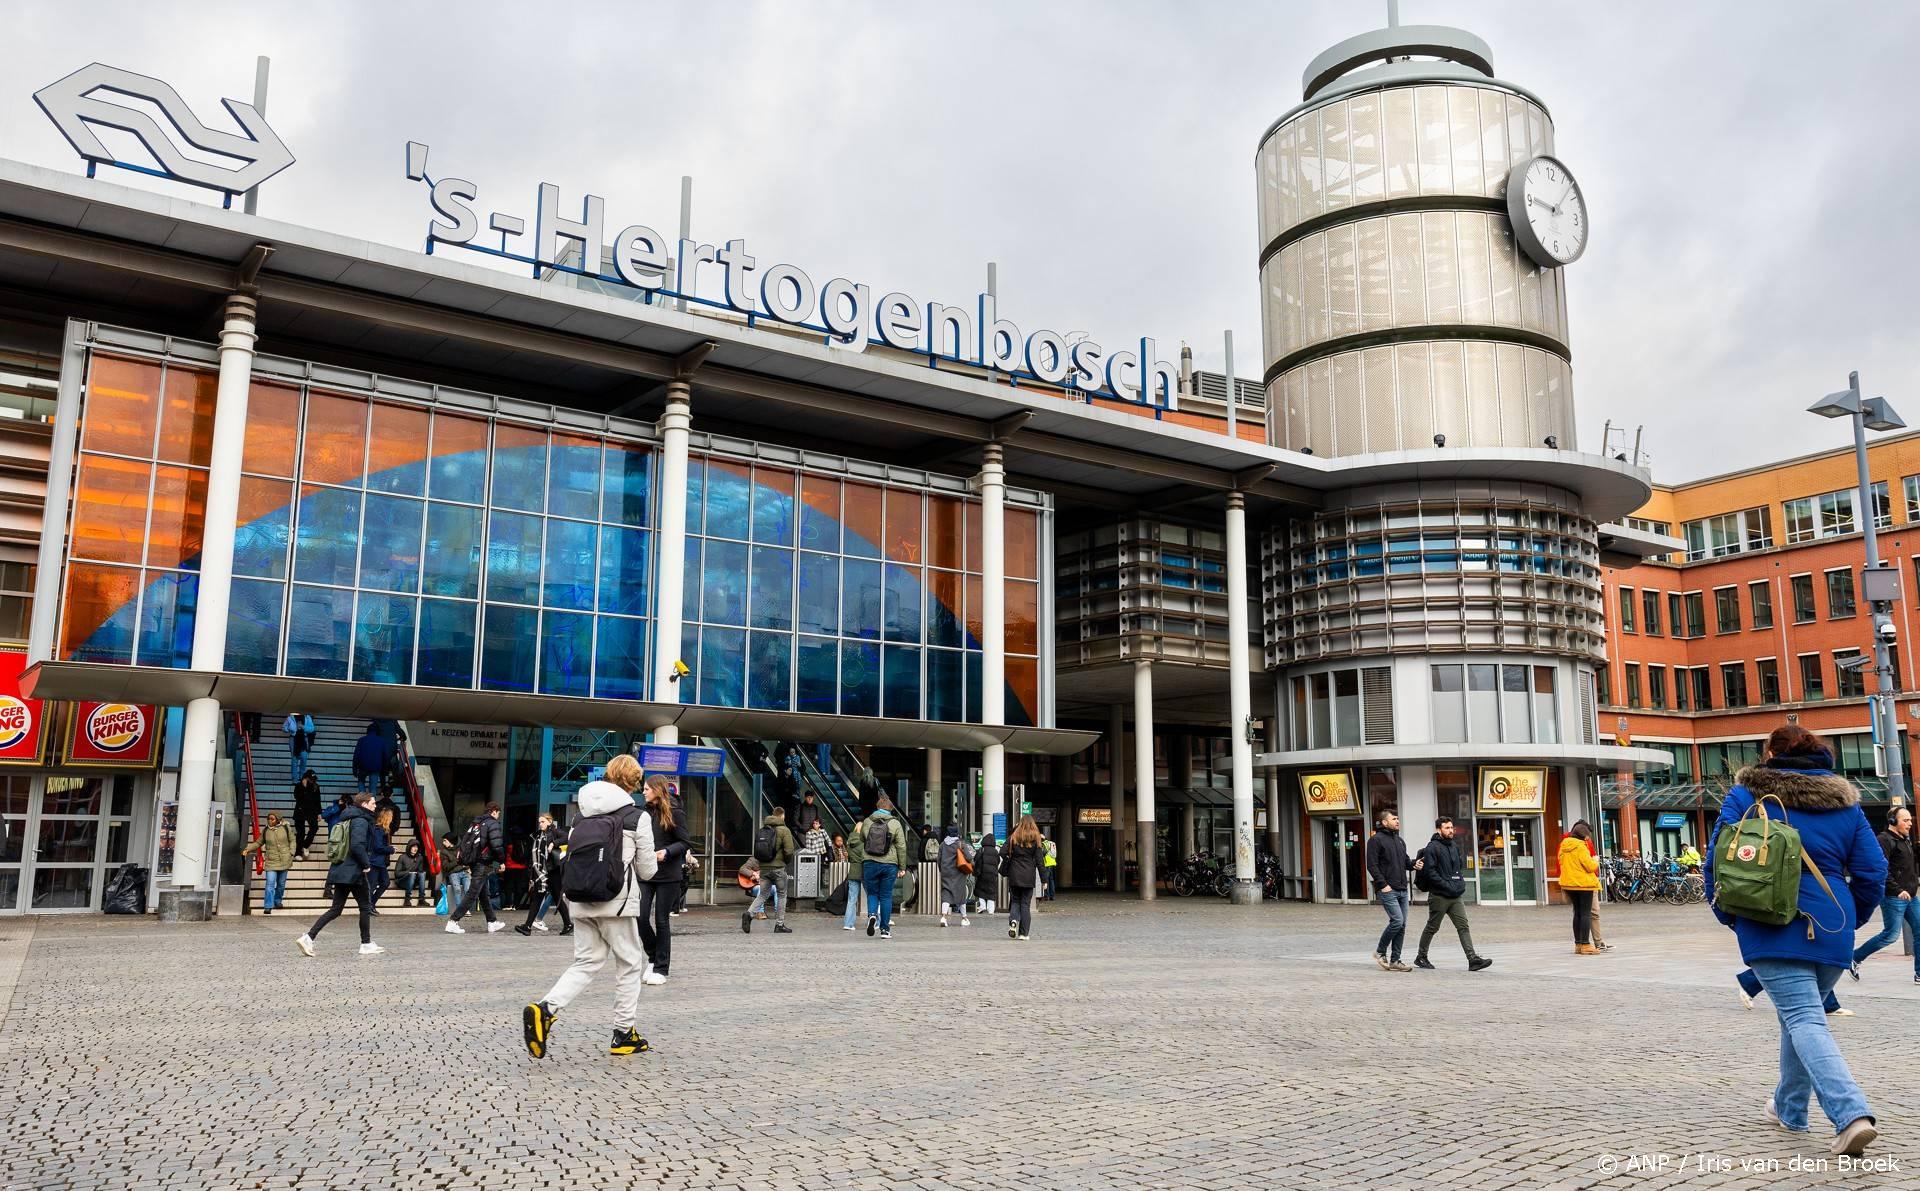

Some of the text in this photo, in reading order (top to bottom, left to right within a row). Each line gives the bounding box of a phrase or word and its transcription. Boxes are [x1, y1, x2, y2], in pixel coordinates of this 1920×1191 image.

[1546, 167, 1555, 181] 12
[1527, 193, 1533, 207] 9
[1573, 213, 1579, 226] 3
[1553, 240, 1559, 253] 6
[406, 140, 1178, 412] 's-Hertogenbosch
[93, 710, 138, 728] BURGER
[93, 720, 139, 742] KING
[431, 728, 440, 736] AL
[1324, 780, 1339, 788] the
[1512, 776, 1529, 787] the
